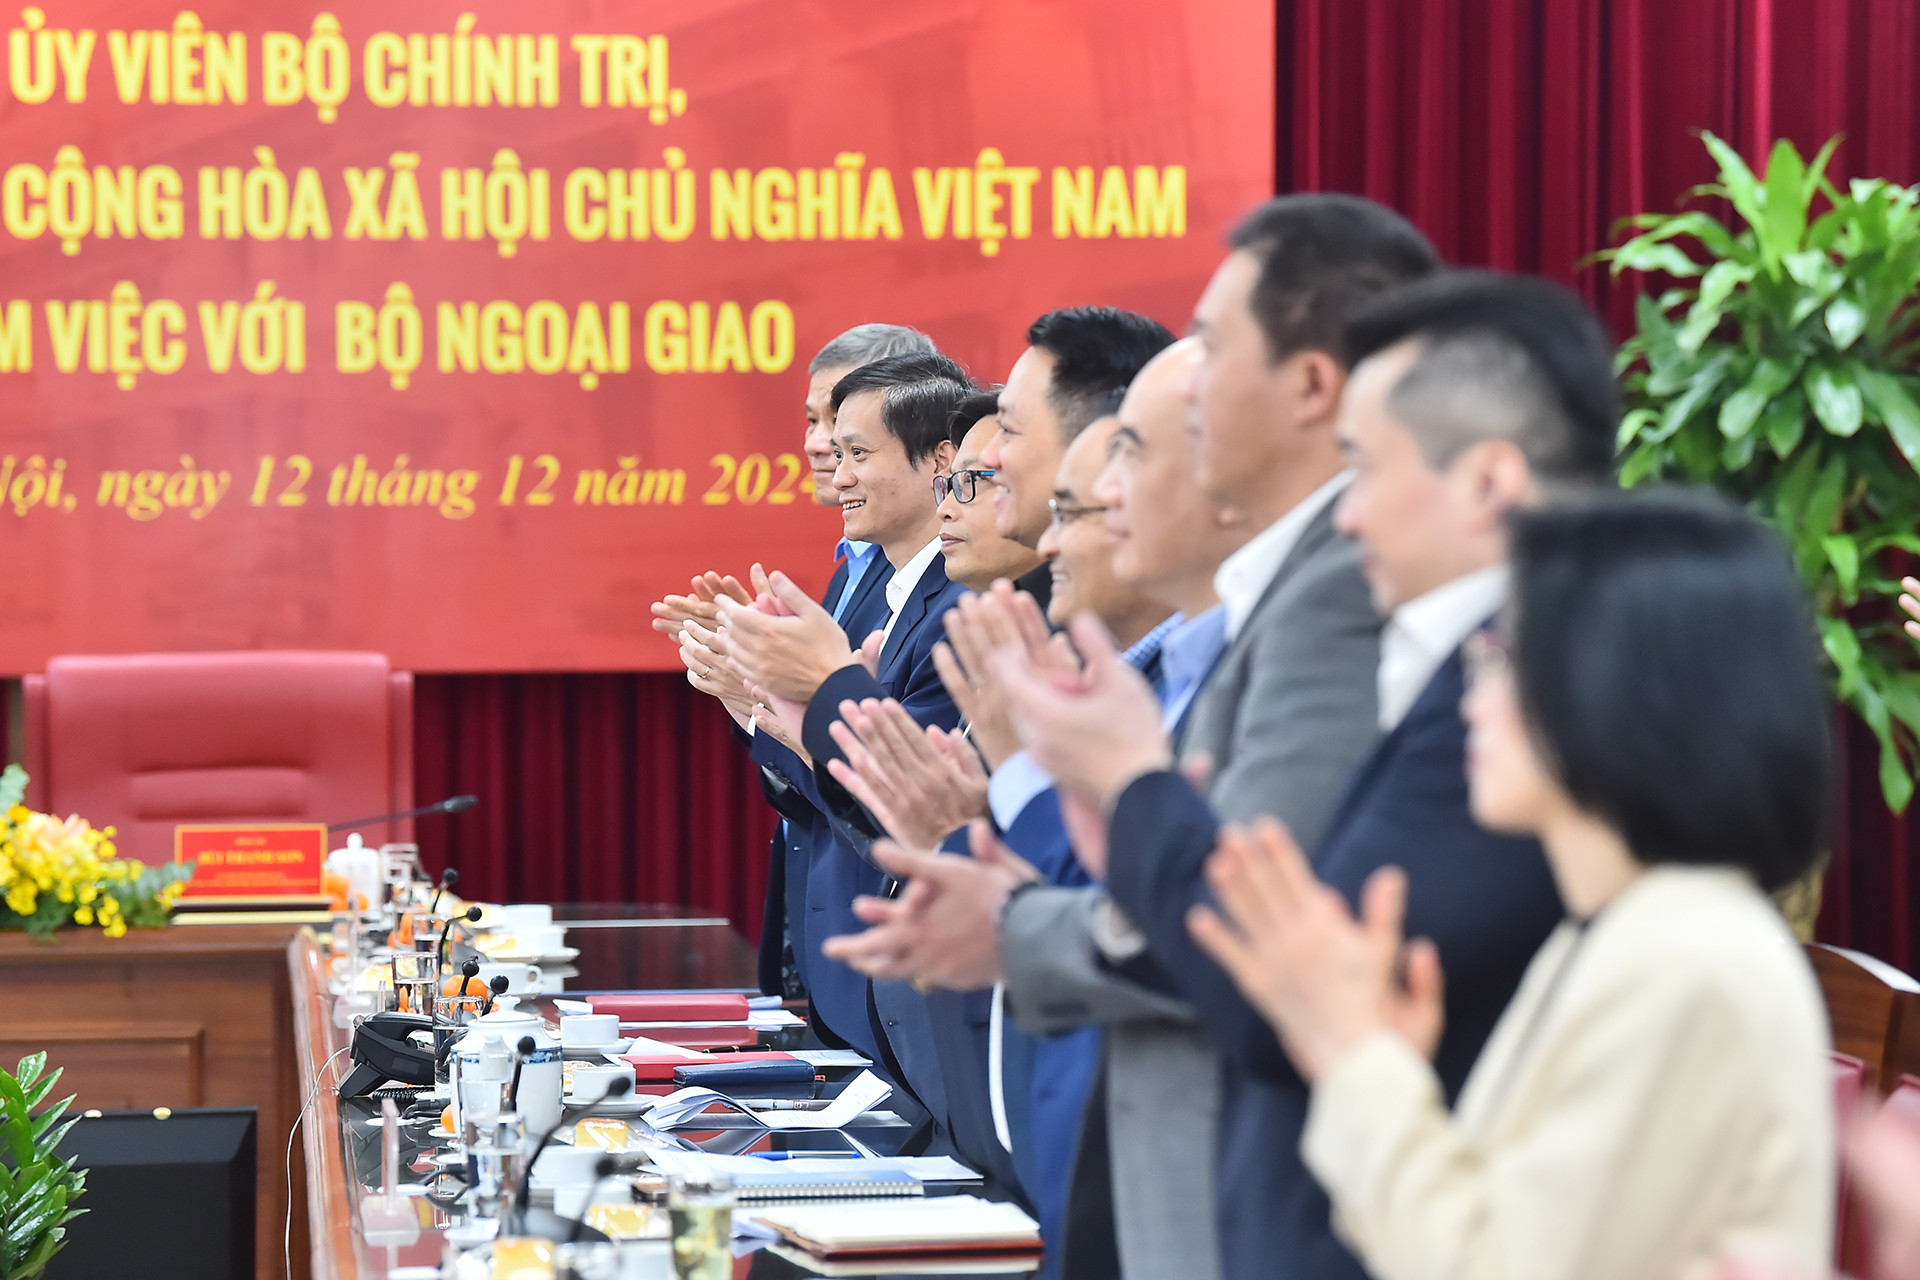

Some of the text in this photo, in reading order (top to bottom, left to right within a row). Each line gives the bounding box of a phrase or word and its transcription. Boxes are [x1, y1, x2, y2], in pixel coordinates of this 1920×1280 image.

[8, 6, 688, 125] ỦY VIÊN BỘ CHÍNH TRỊ,
[2, 144, 1187, 258] CỘNG HÒA XÃ HỘI CHỦ NGHĨA VIỆT NAM
[45, 279, 187, 391] VIỆC
[198, 279, 306, 374] VỚI
[335, 281, 423, 391] BỘ
[436, 300, 631, 391] NGOẠI
[643, 299, 795, 375] GIAO
[96, 456, 230, 520] ngày
[251, 455, 312, 506] 12
[327, 454, 479, 519] tháng
[499, 454, 561, 506] 12
[573, 456, 687, 506] năm
